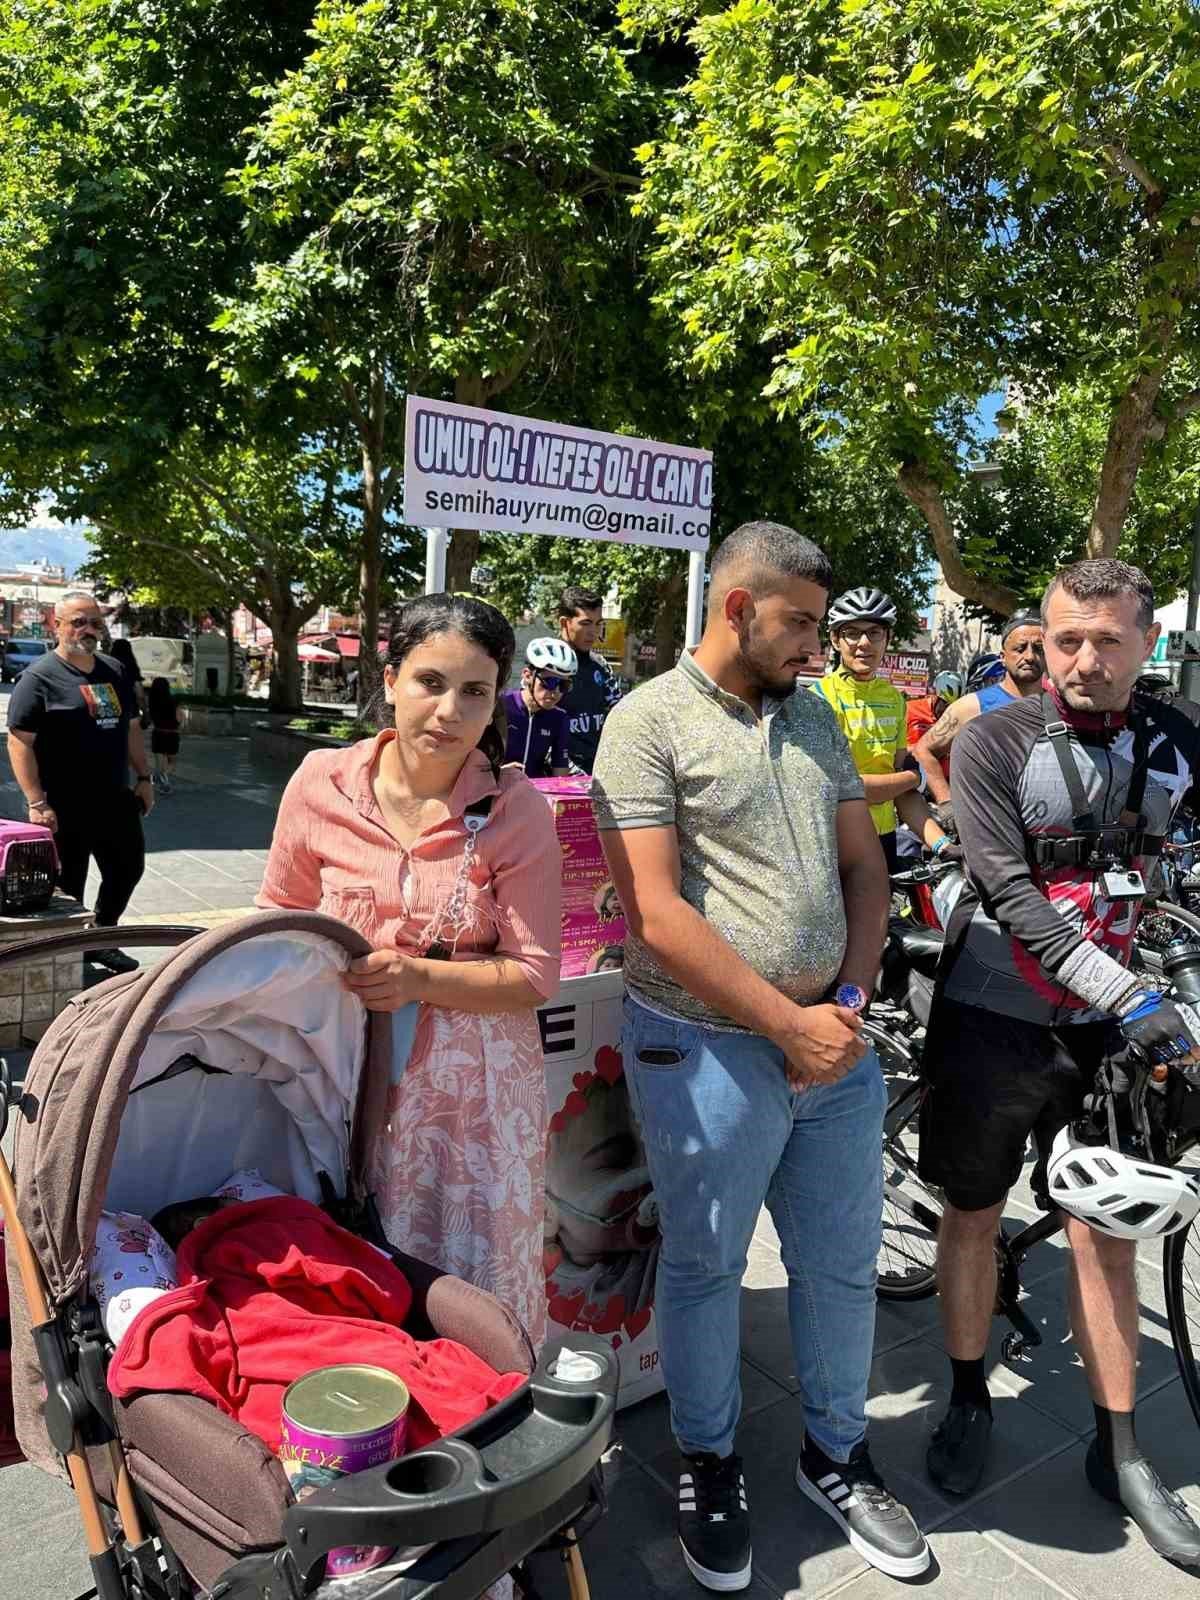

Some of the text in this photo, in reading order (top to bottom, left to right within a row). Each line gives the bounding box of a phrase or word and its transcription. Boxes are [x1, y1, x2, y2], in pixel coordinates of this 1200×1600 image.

[415, 409, 488, 479] UMUT
[529, 430, 604, 493] NEFES
[650, 453, 700, 507] CAN
